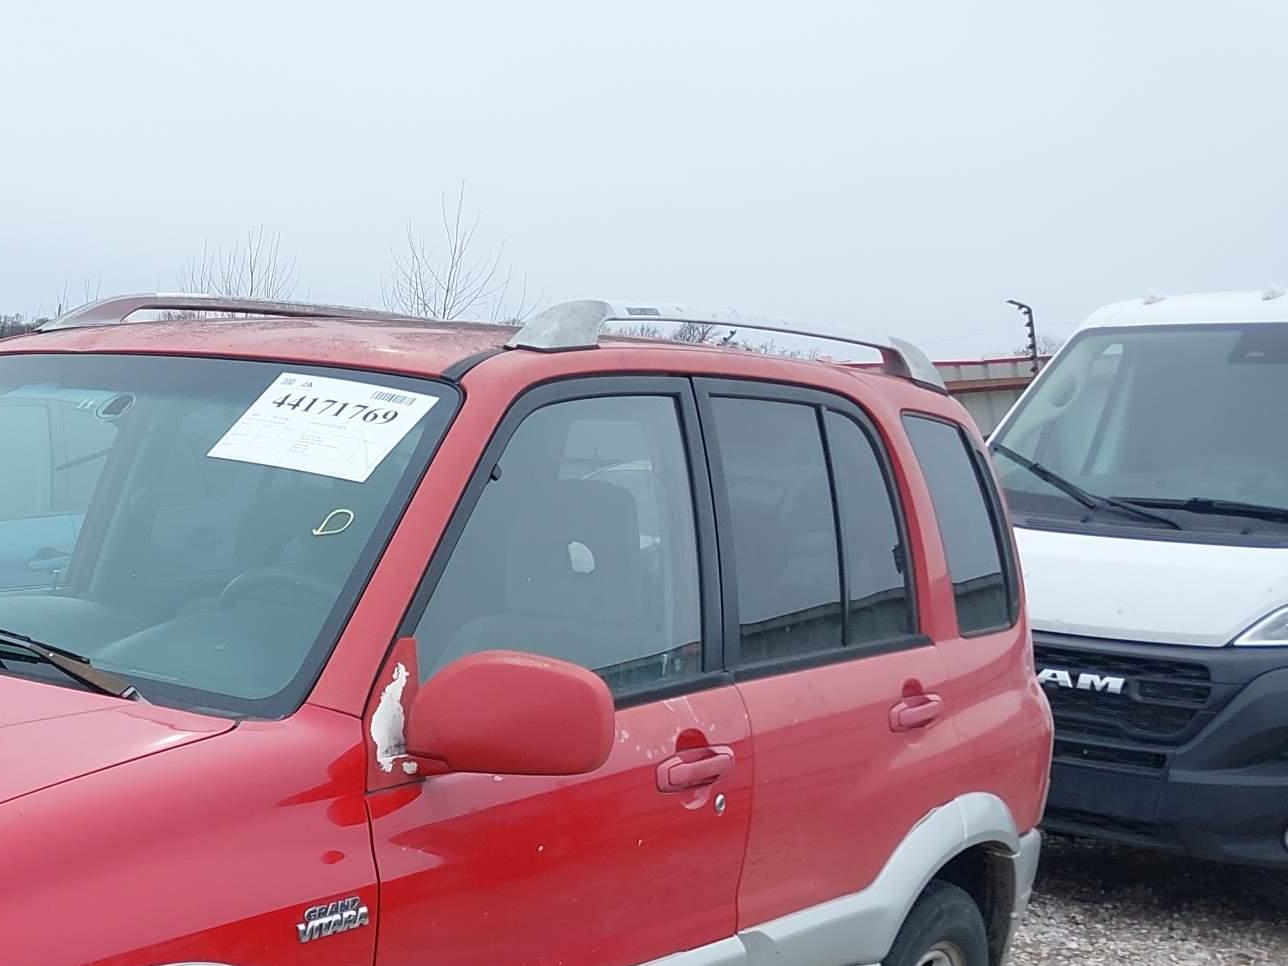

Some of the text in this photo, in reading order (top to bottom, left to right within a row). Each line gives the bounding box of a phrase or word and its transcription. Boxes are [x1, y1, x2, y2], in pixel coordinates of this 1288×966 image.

[272, 393, 399, 425] 44171769
[1037, 669, 1125, 694] AM
[304, 896, 361, 921] GRAND
[296, 906, 369, 943] VITARA
